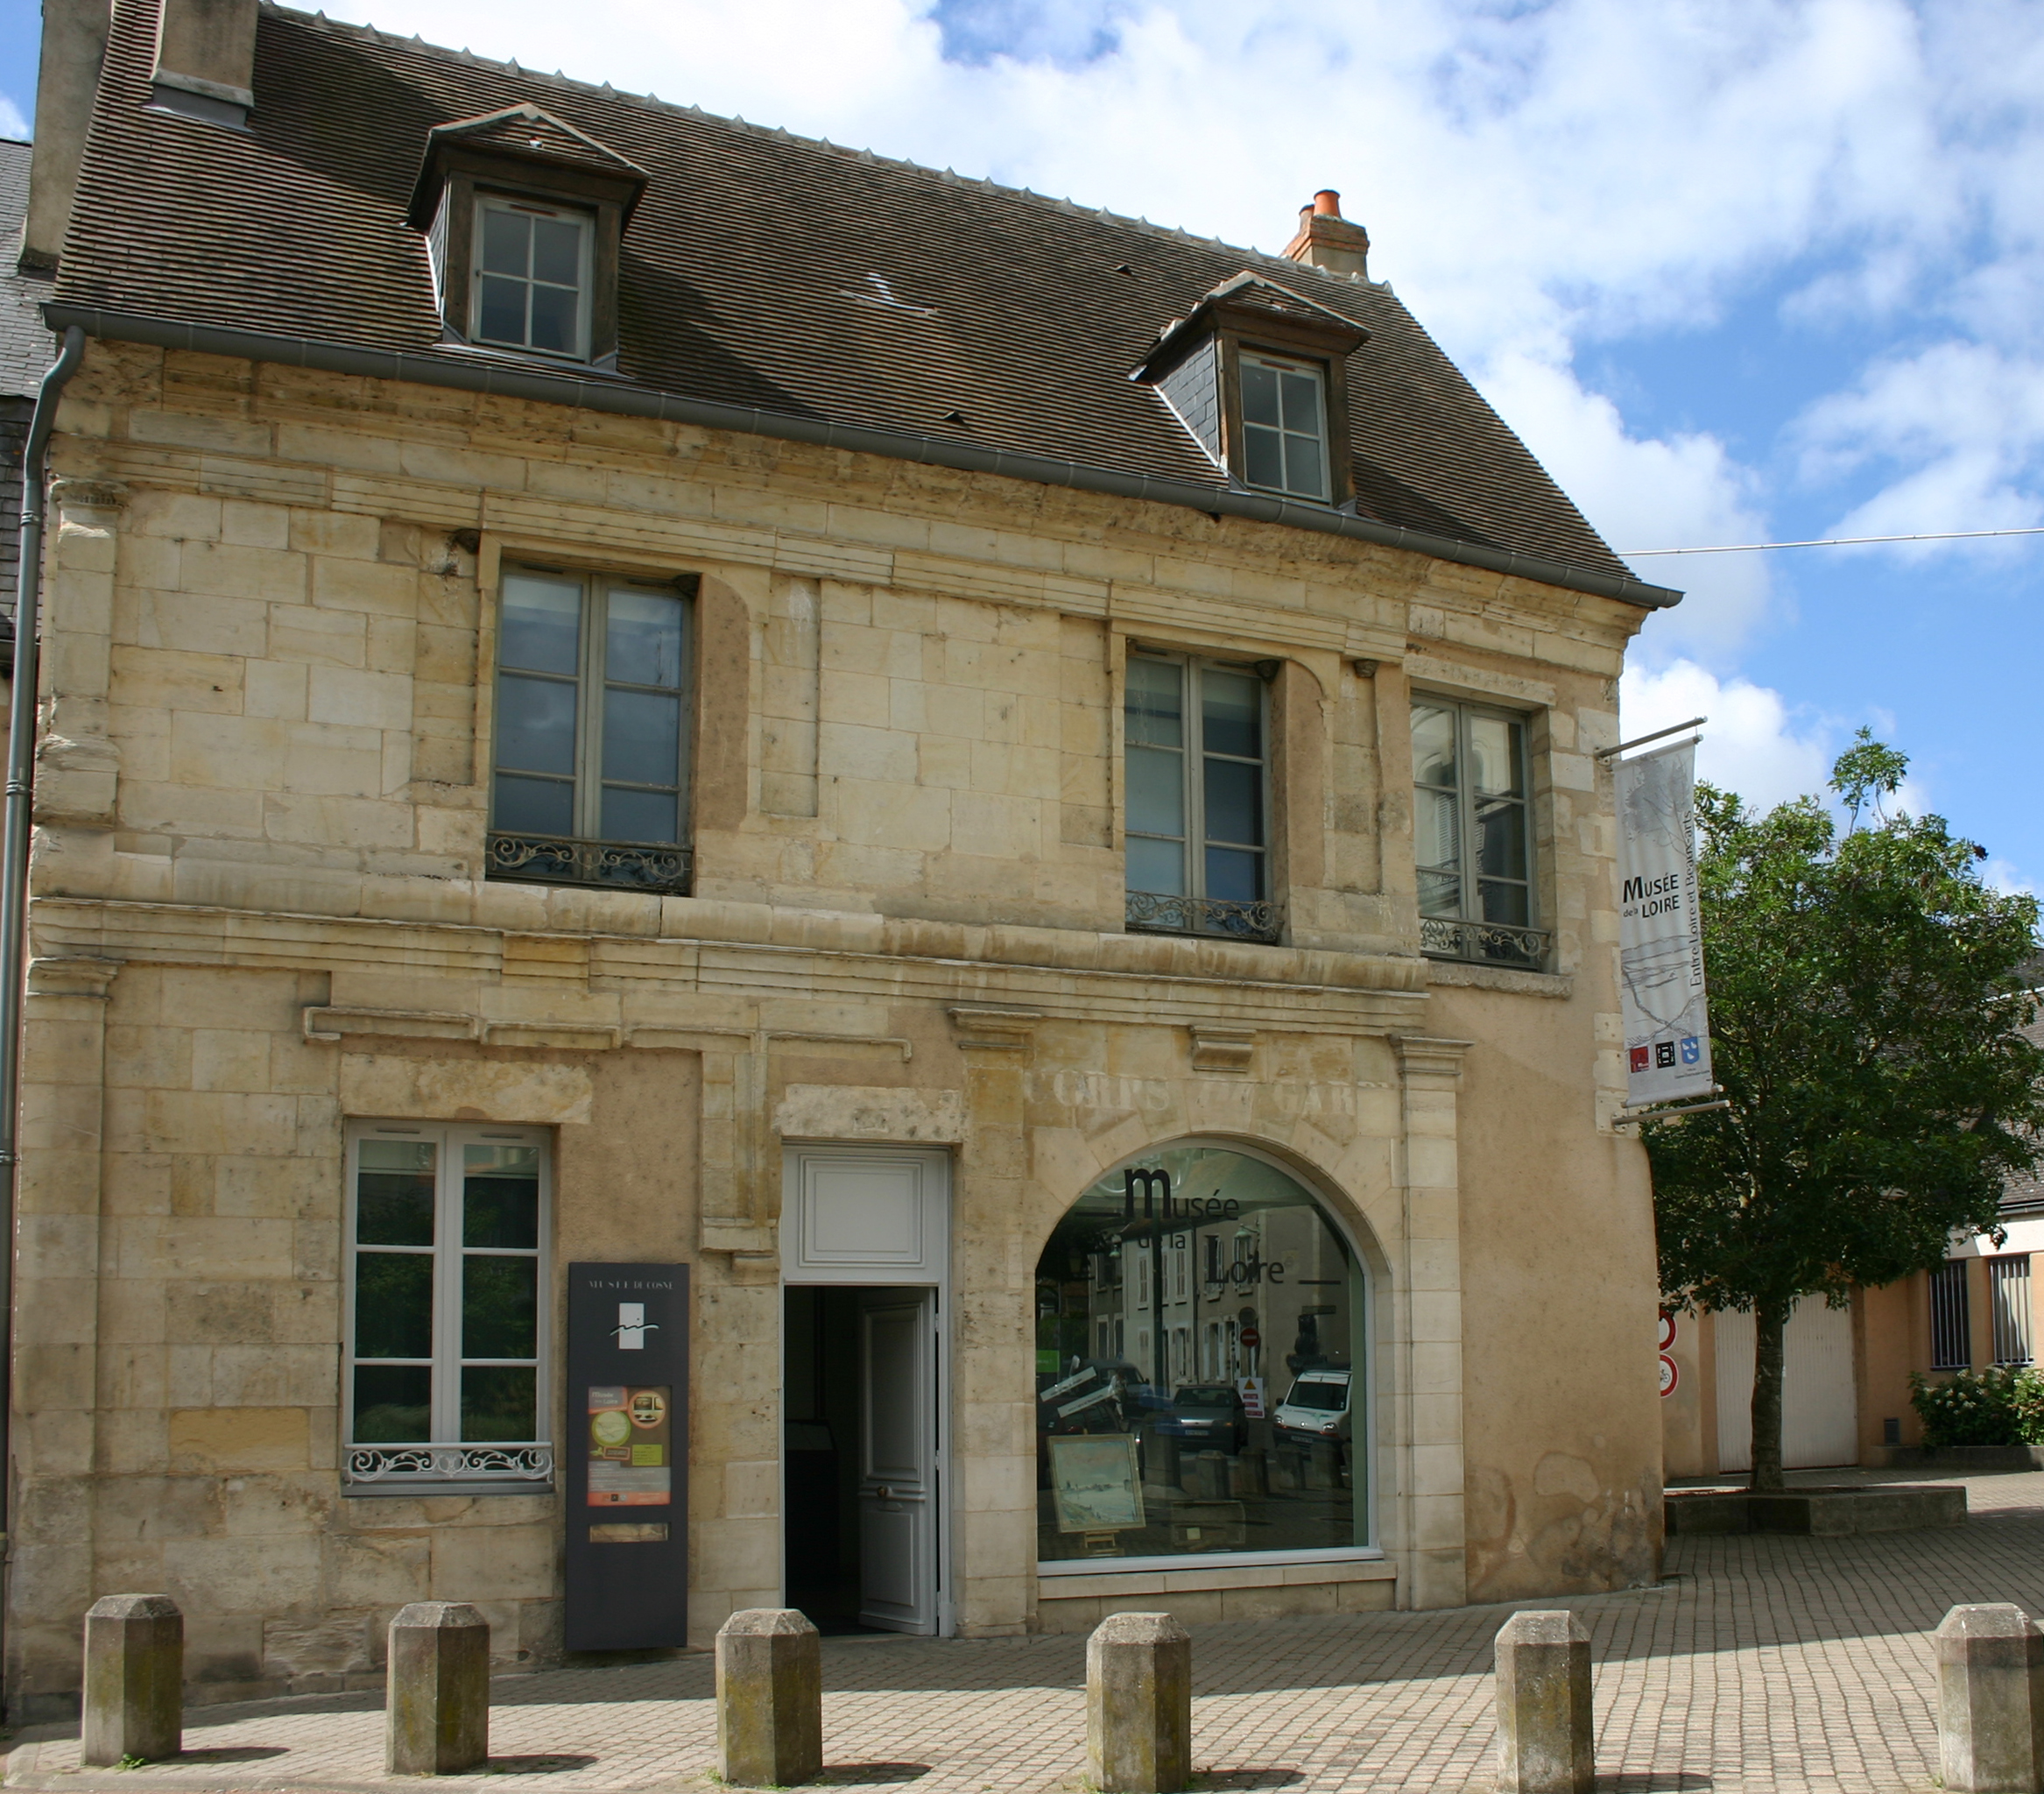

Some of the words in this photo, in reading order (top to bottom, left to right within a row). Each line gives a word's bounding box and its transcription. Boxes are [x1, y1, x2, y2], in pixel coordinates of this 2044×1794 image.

[1641, 894, 1680, 919] LOIRE
[1687, 890, 1696, 903] et
[1688, 907, 1699, 943] Loire
[1689, 947, 1702, 987] Entre
[1205, 1235, 1285, 1284] Loire
